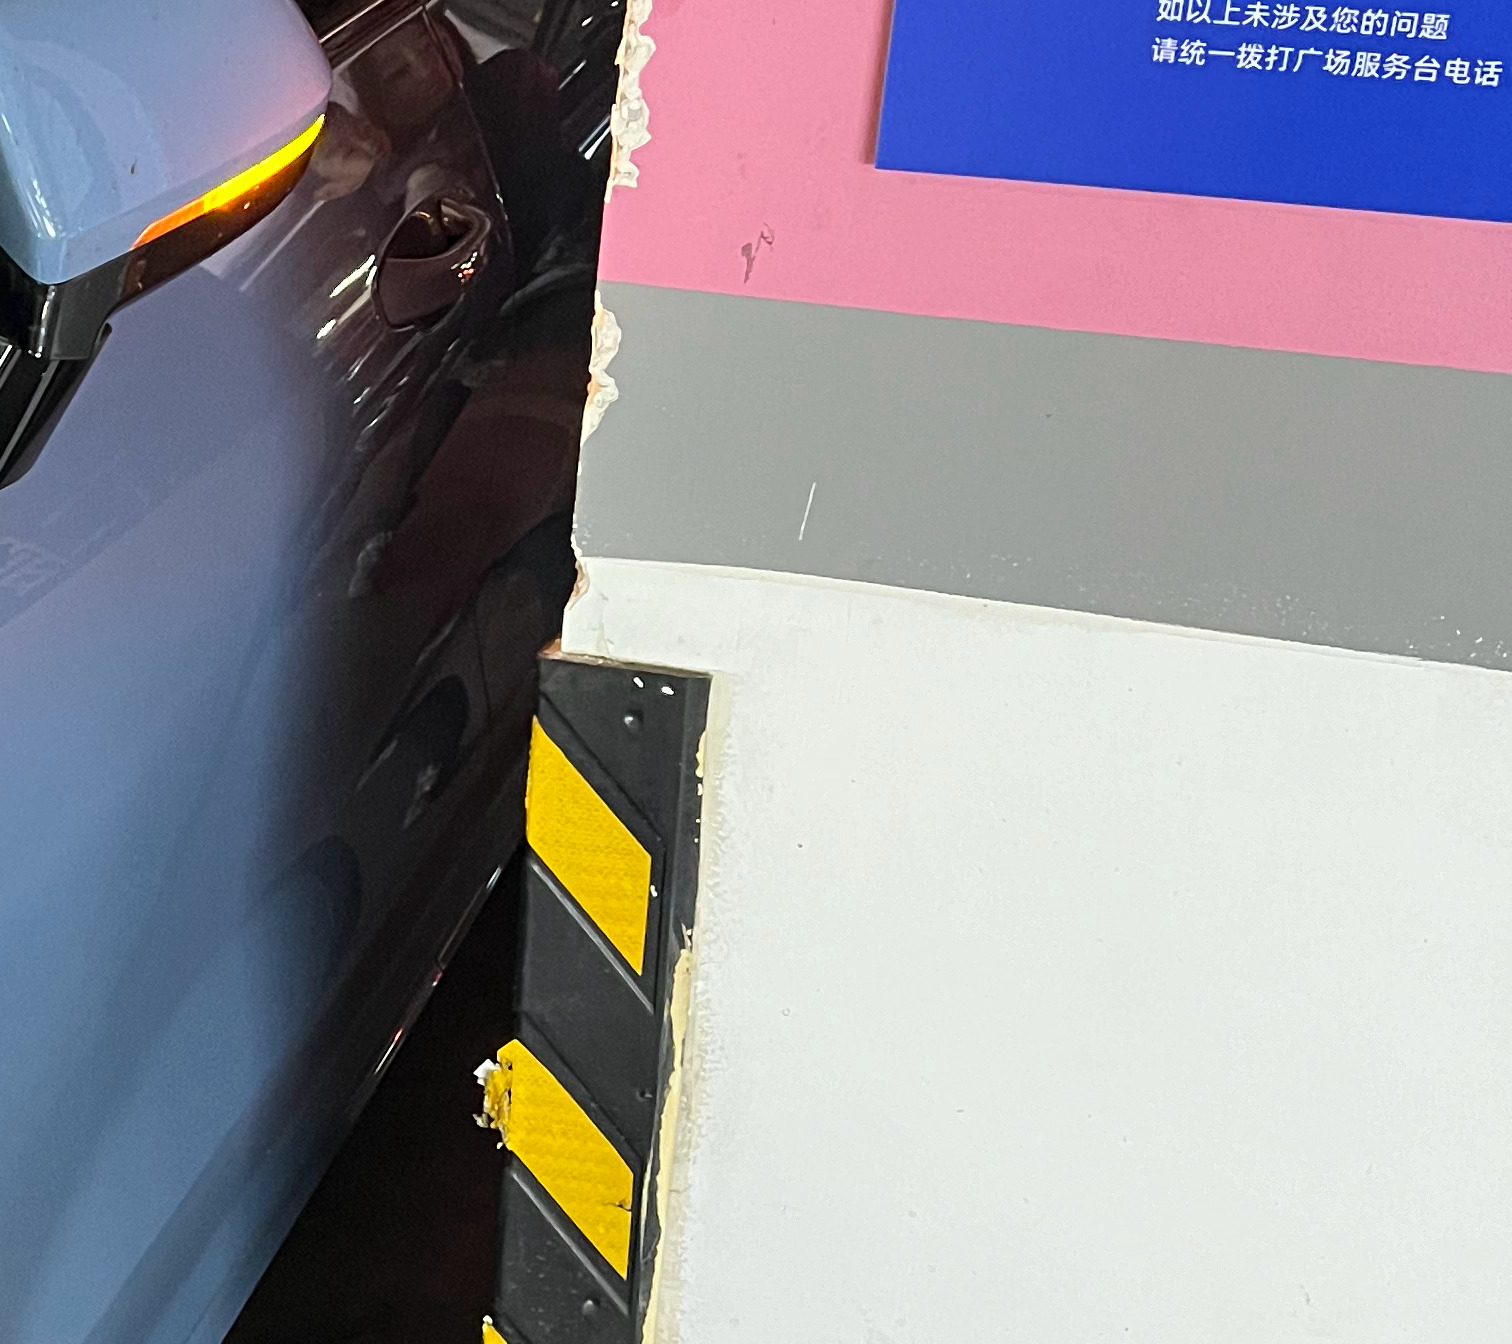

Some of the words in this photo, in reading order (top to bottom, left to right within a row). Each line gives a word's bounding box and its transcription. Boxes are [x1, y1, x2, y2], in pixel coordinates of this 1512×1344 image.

[1150, 36, 1504, 88] 请统一拨打广场服务台电话
